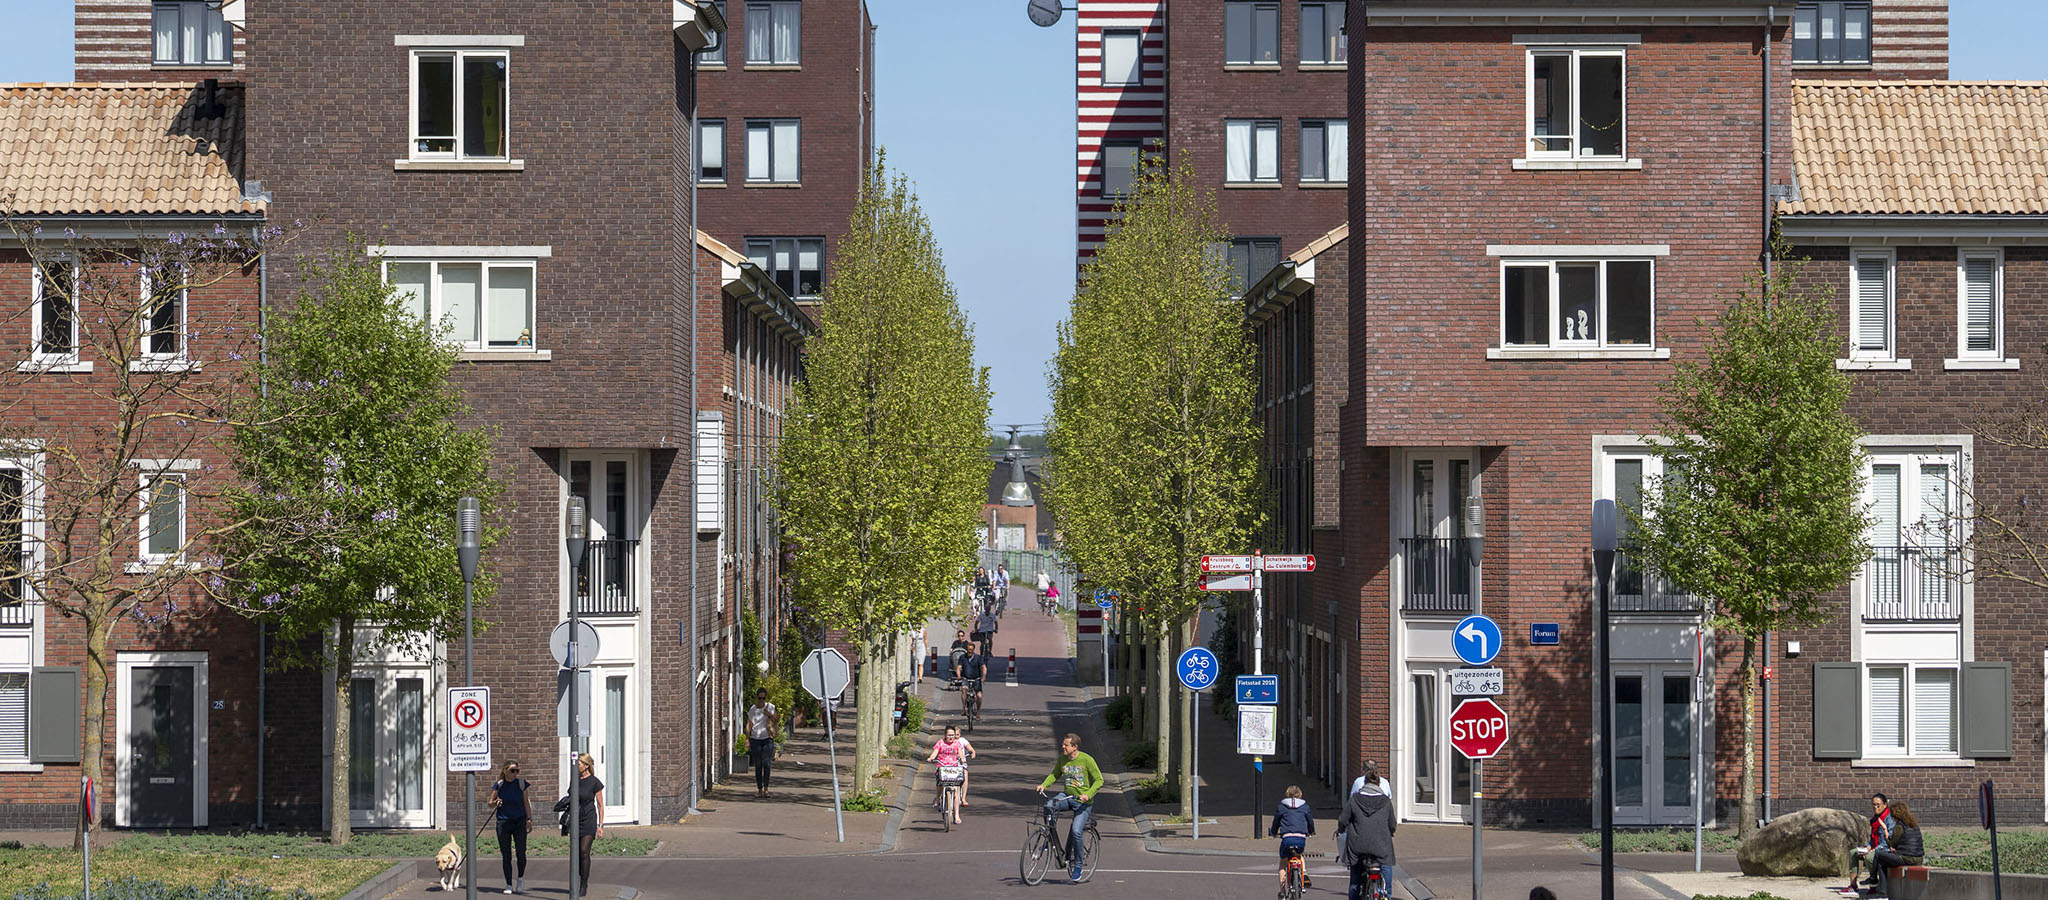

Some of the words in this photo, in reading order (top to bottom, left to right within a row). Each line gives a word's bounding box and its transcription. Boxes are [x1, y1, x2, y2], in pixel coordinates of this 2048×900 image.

[1454, 671, 1501, 679] uitgezonderd
[214, 701, 225, 709] 28
[1452, 717, 1504, 741] STOP
